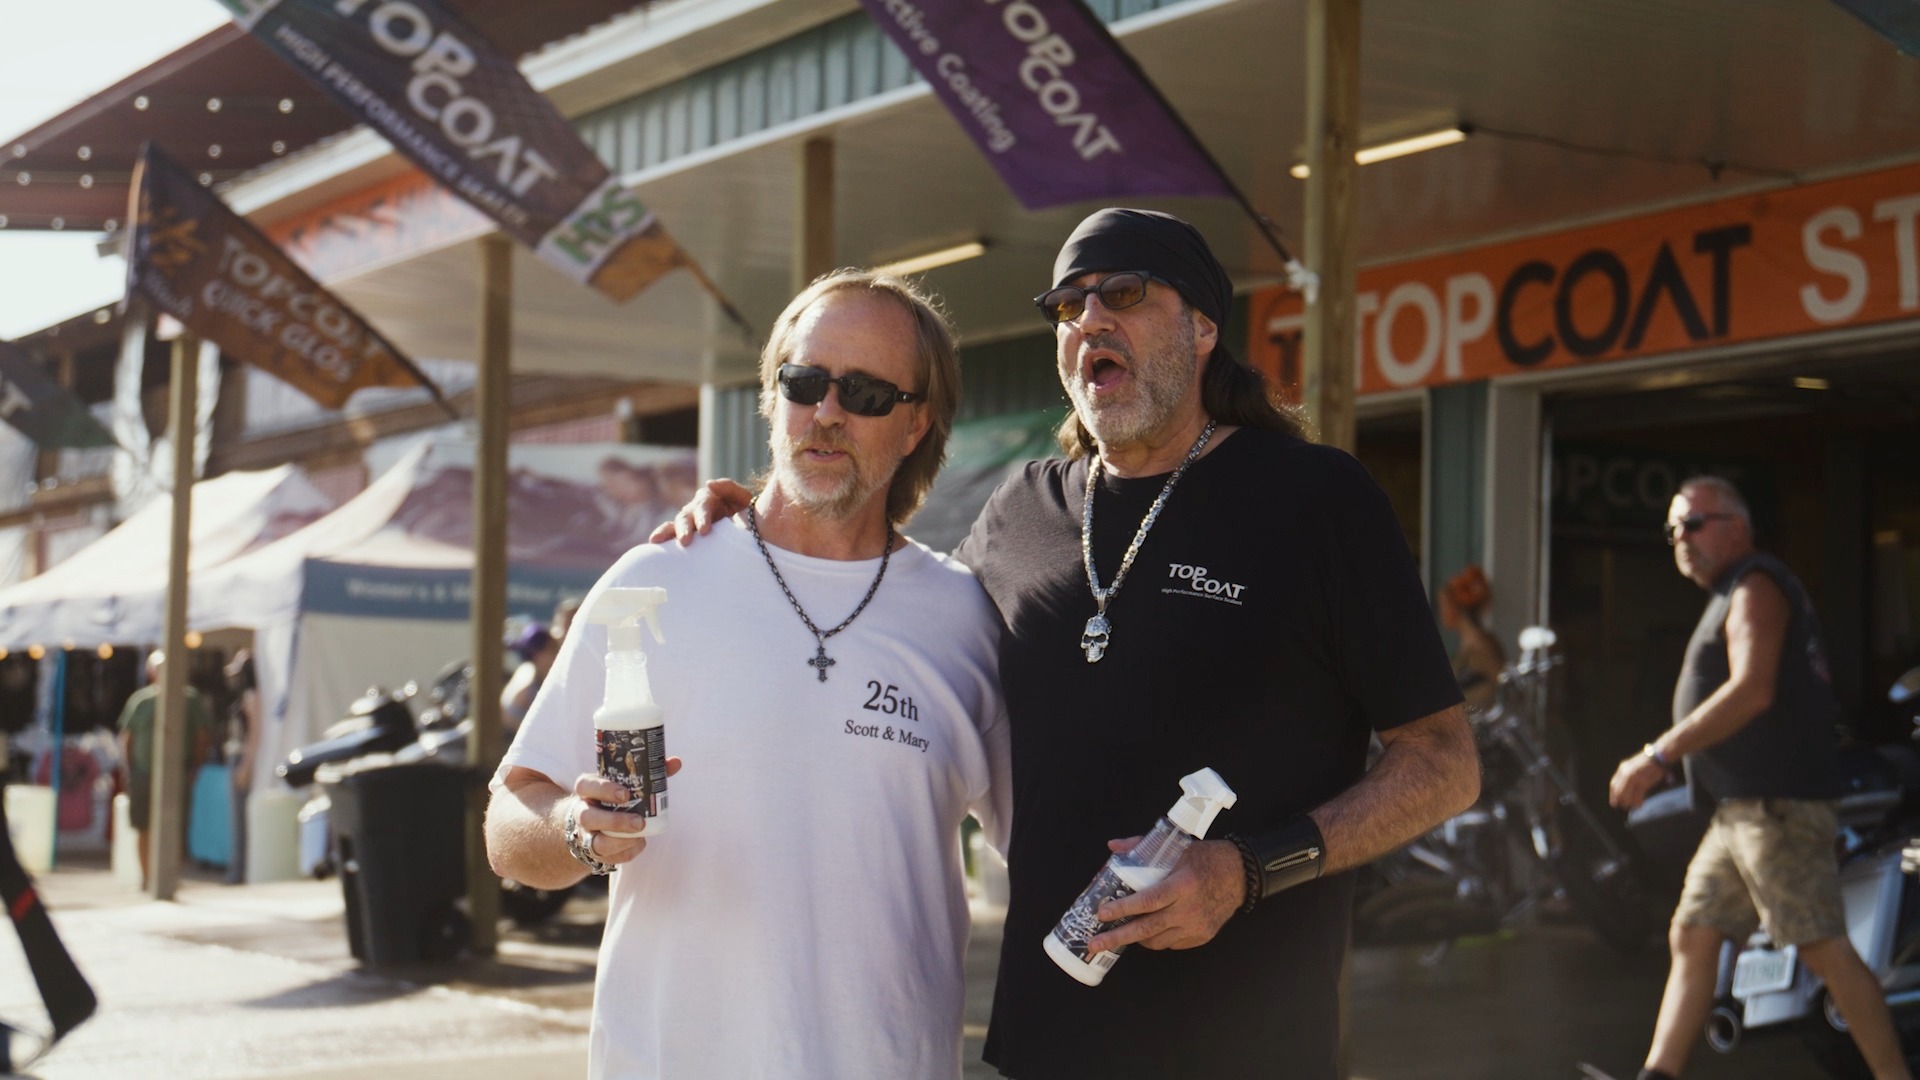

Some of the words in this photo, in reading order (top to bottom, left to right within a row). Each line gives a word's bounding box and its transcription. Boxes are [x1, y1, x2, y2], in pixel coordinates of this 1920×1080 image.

[985, 0, 1075, 67] OP
[406, 70, 559, 198] COAT
[936, 53, 1016, 153] Coating
[1019, 56, 1124, 161] COAT
[1801, 193, 1920, 325] ST
[1168, 563, 1208, 580] TOP
[1191, 577, 1246, 599] COAT
[862, 680, 919, 722] 25th
[844, 719, 880, 739] Scott
[882, 726, 895, 741] &
[898, 728, 930, 753] Mary
